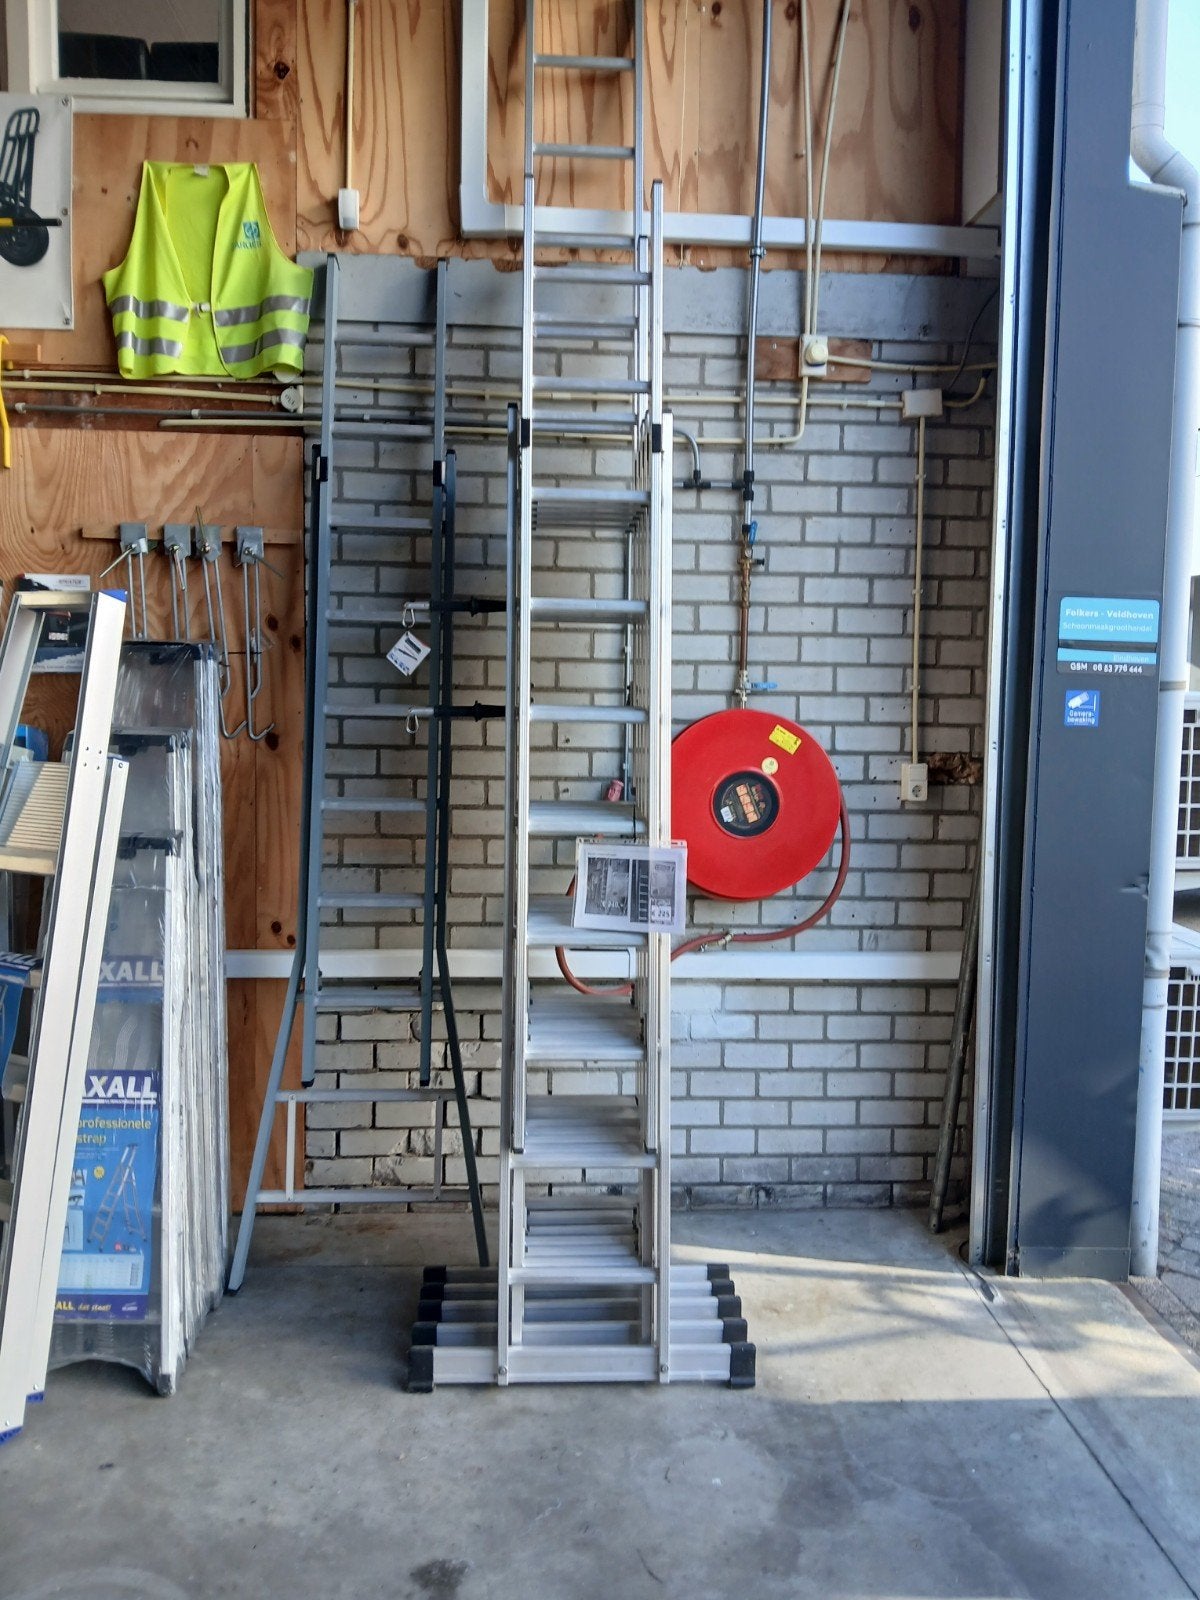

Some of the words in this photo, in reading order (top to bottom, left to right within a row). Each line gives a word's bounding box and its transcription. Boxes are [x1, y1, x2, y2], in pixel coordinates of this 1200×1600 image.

[1066, 609, 1098, 617] Folkers
[1107, 610, 1153, 619] Veldhoven
[1070, 662, 1087, 670] GSM
